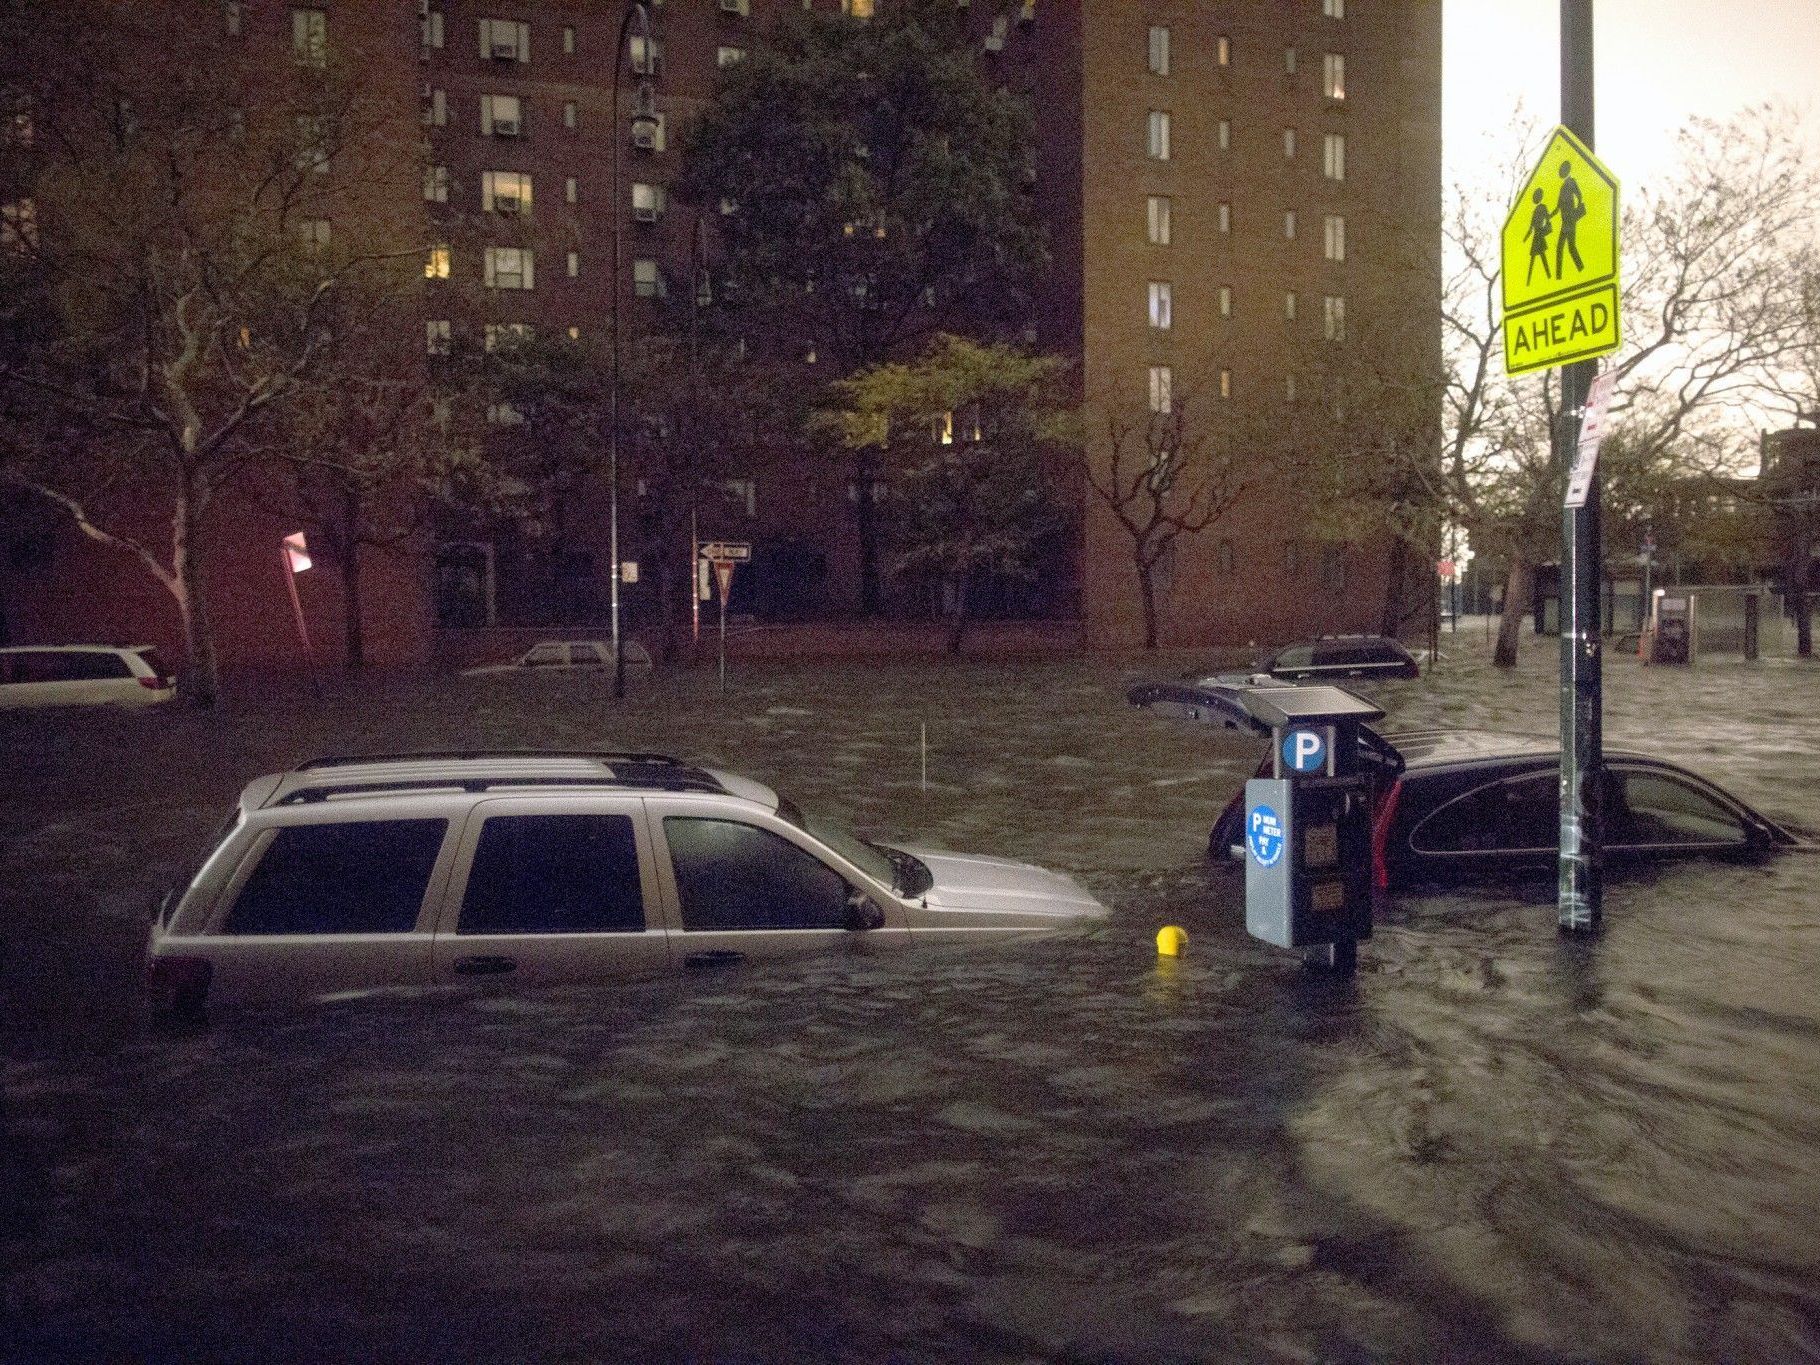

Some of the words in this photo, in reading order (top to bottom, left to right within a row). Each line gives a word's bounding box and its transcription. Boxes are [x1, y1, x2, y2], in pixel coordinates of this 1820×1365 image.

[1513, 303, 1608, 355] AHEAD
[1296, 733, 1320, 769] P
[1252, 812, 1262, 832] P
